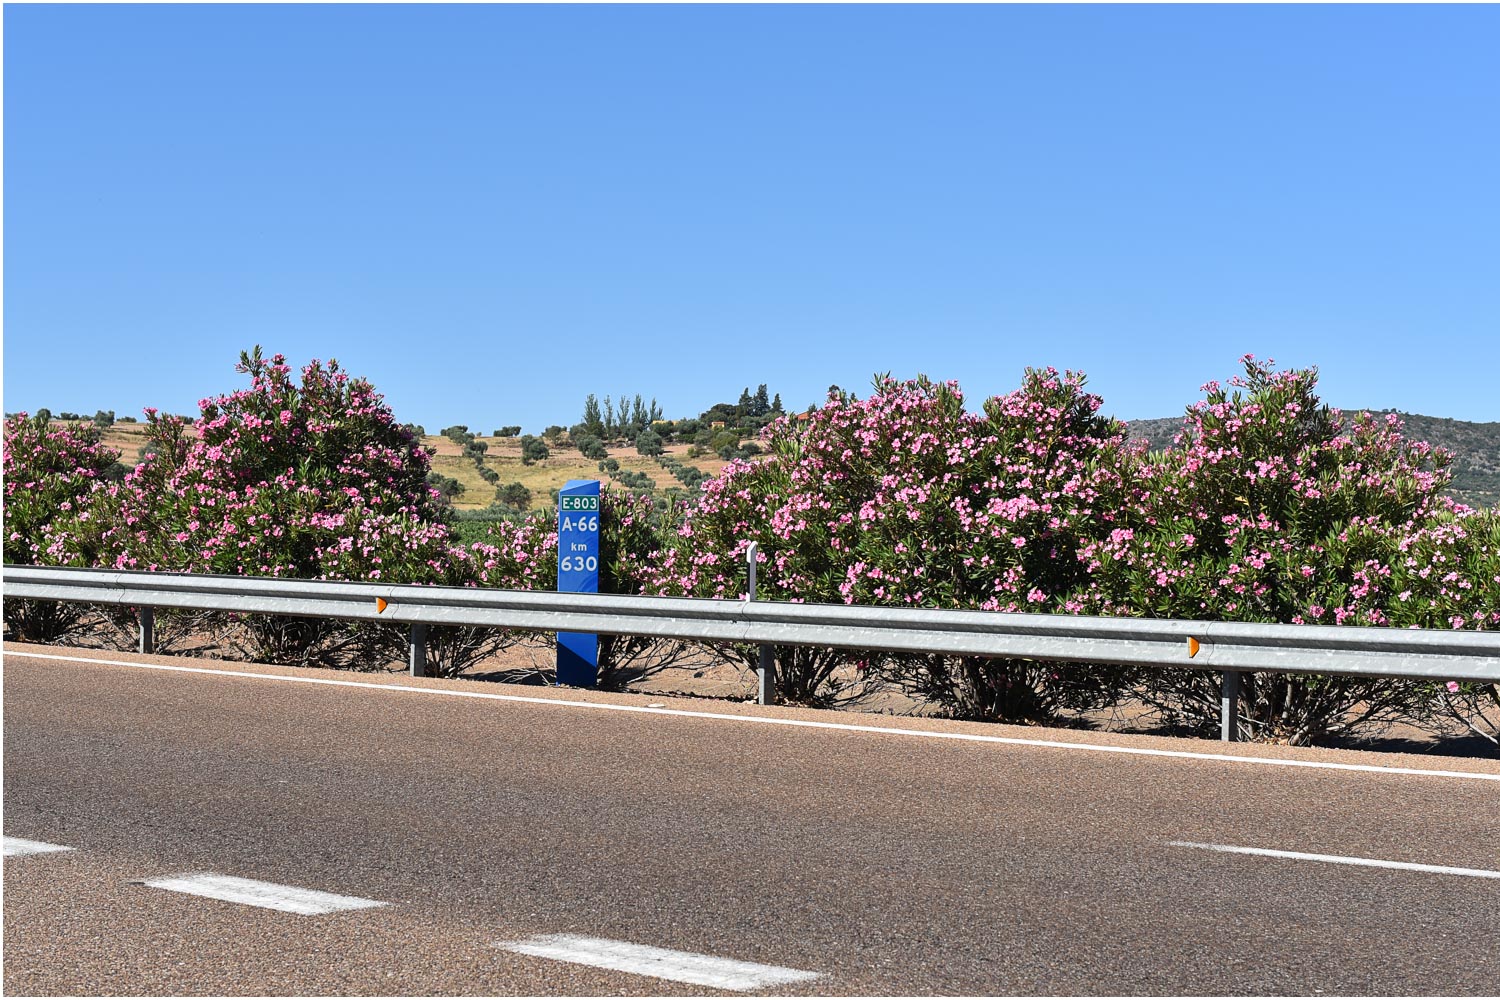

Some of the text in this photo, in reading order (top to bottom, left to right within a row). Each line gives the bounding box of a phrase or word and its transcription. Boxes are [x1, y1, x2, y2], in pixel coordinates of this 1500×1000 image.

[562, 497, 597, 510] E-803
[562, 516, 598, 532] A-66
[571, 542, 588, 552] km
[561, 555, 598, 572] 630
